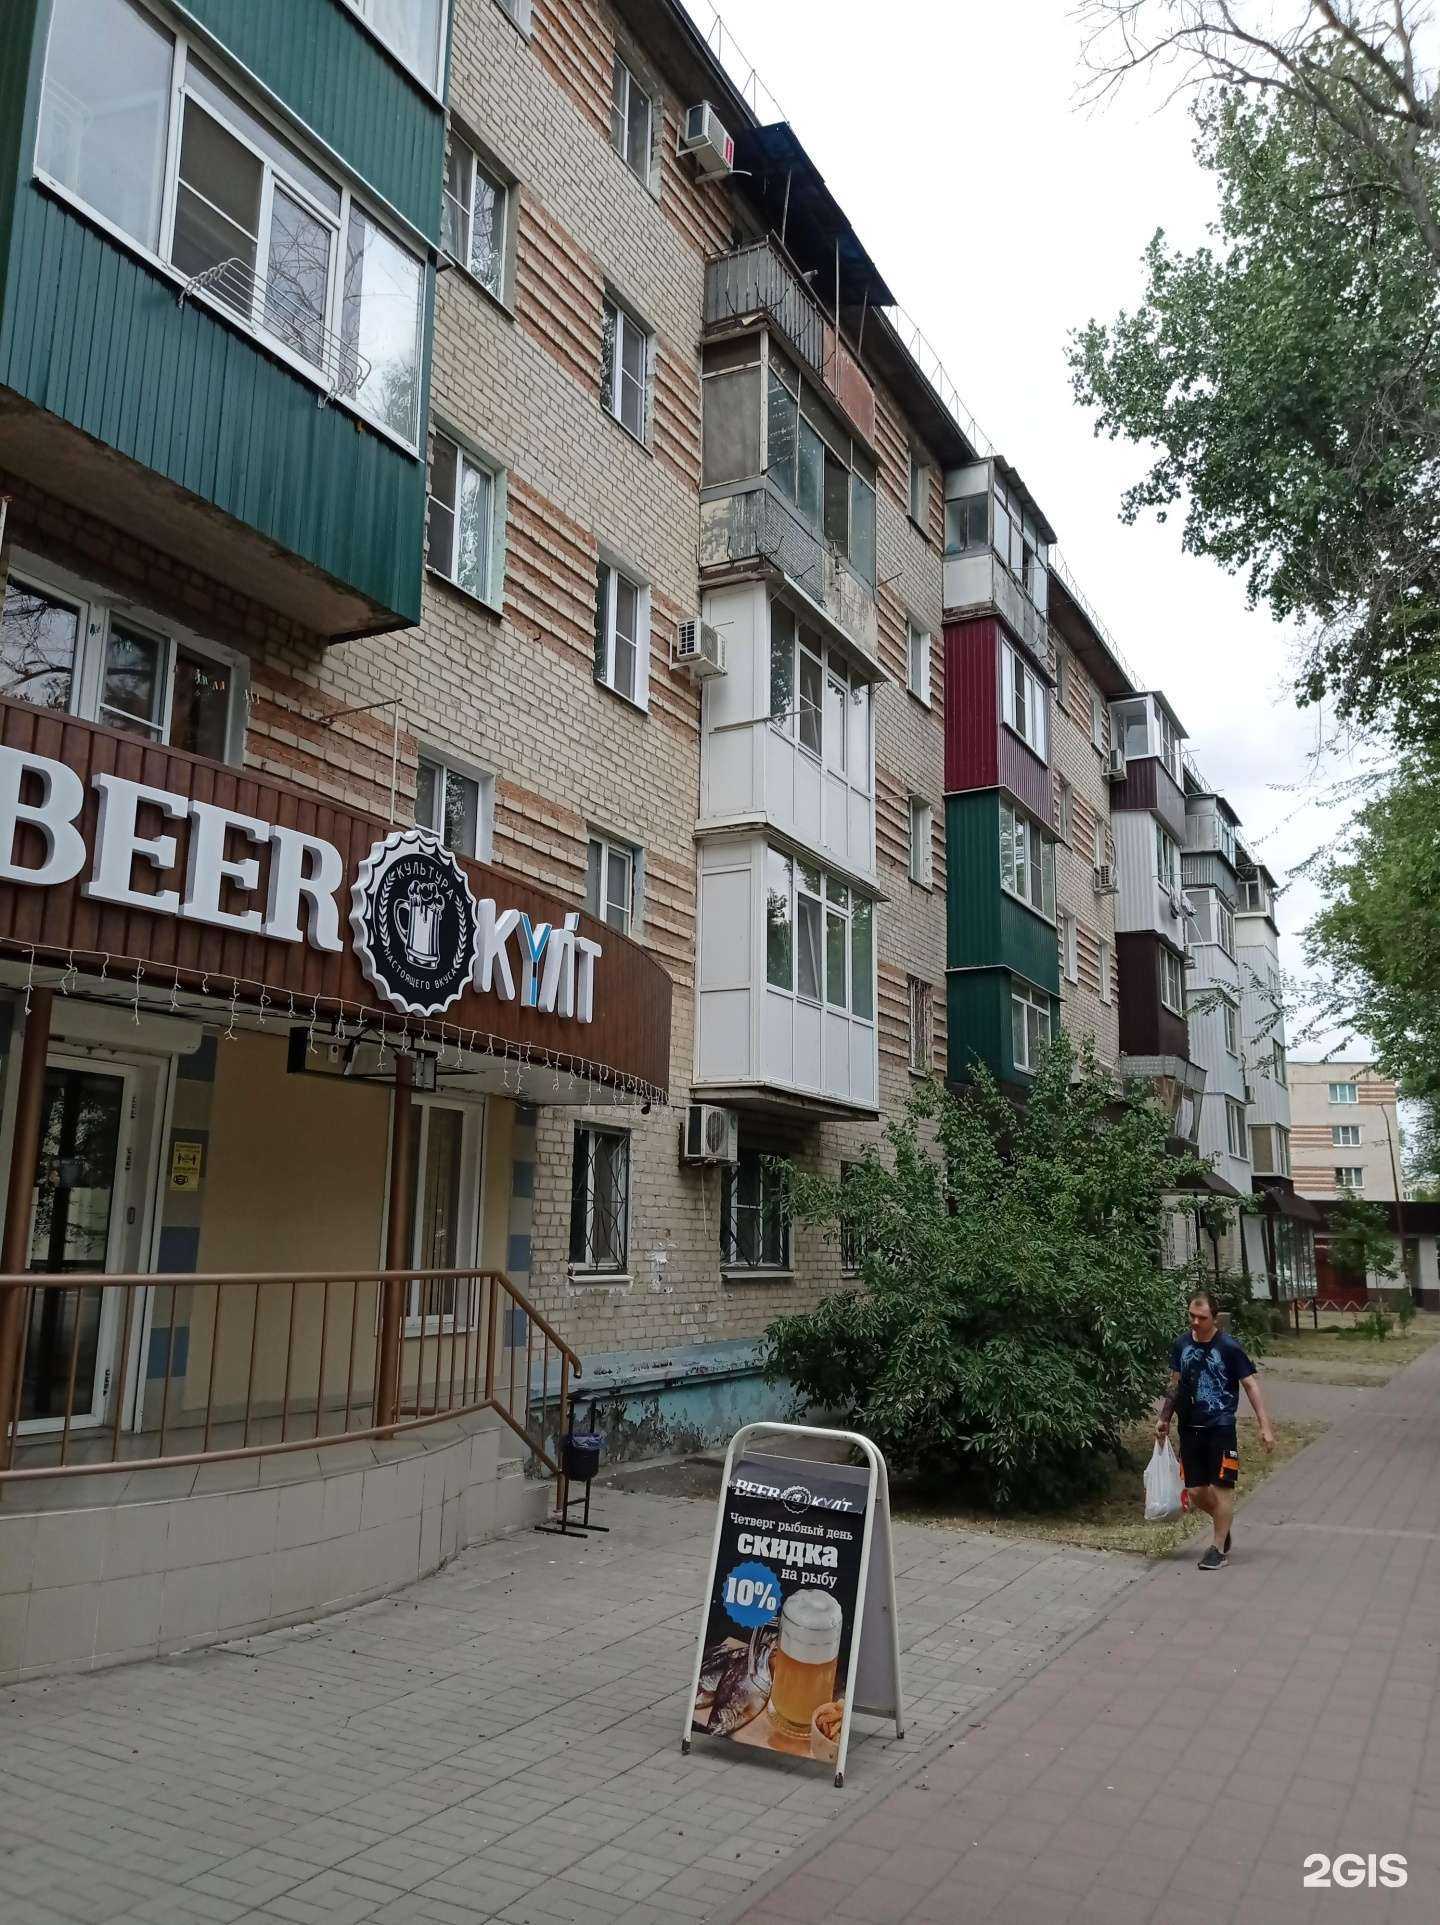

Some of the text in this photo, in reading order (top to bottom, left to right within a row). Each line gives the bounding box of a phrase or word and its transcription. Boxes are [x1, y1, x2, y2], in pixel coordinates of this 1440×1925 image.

[0, 745, 343, 952] BEER
[396, 862, 454, 901] КУЛЬТУРА
[384, 946, 457, 990] НАСТОЯЩЕГО ВКУСА
[734, 1478, 781, 1500] BEER
[730, 1512, 853, 1541] Четверг рыбный день
[737, 1532, 839, 1569] скидка
[725, 1576, 777, 1612] 10%
[780, 1568, 838, 1589] на рыбу
